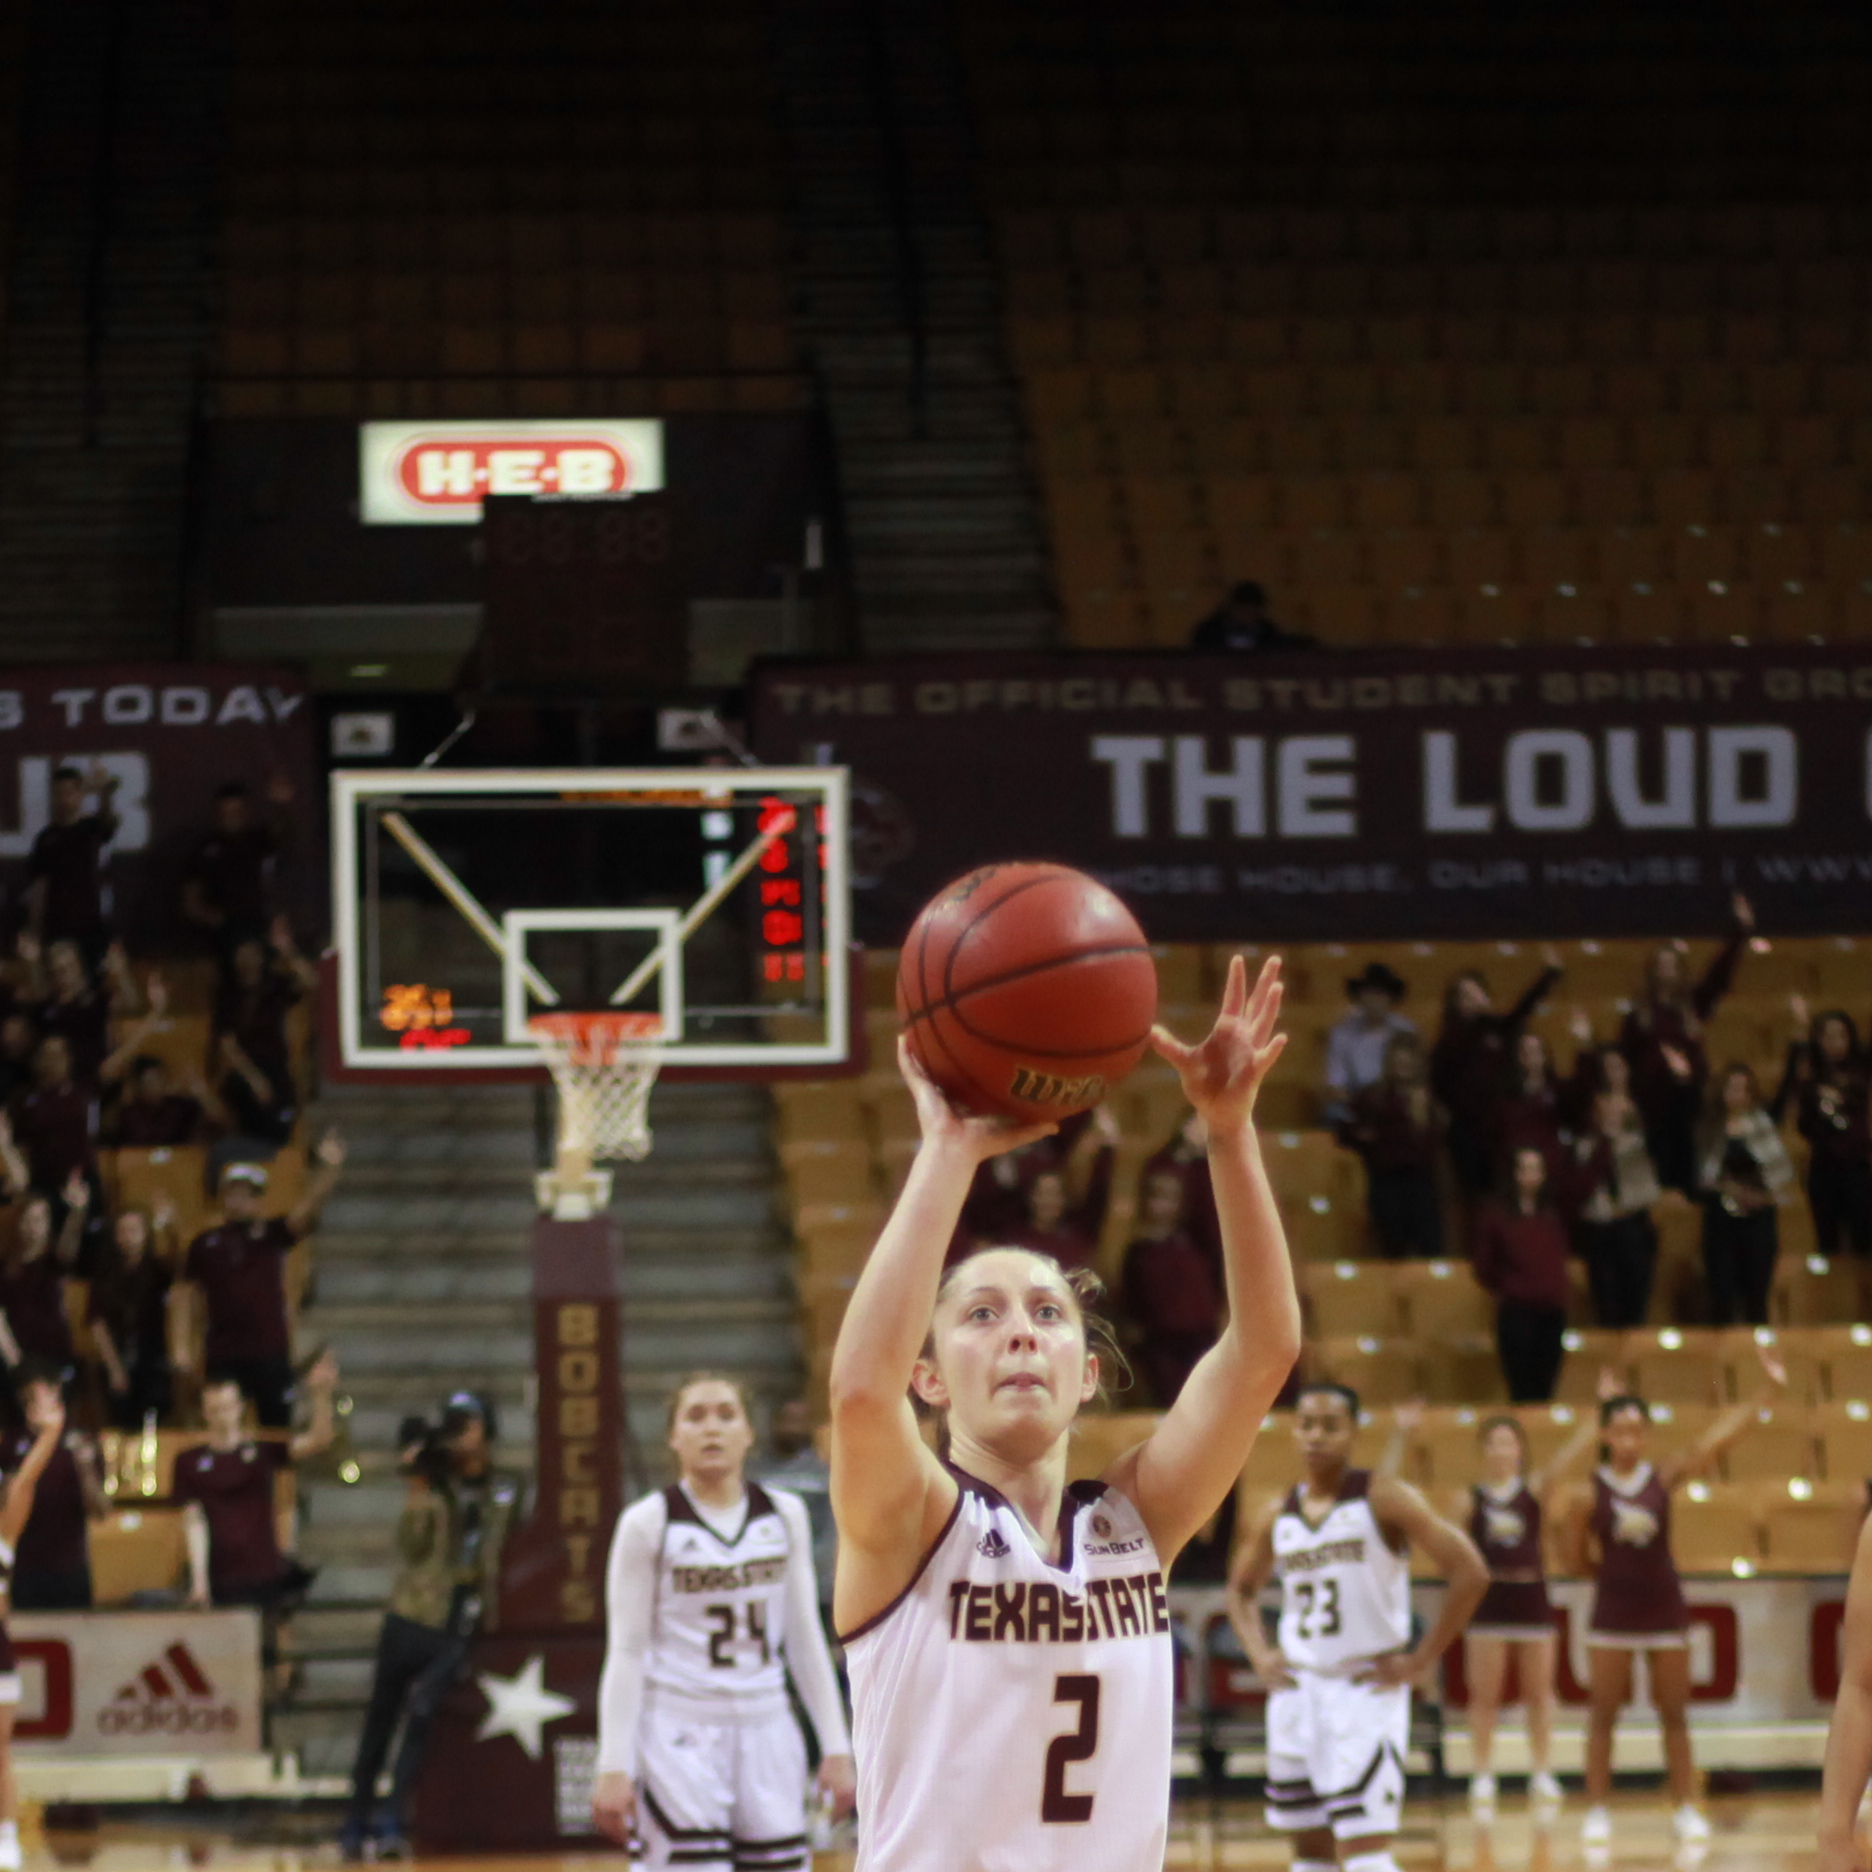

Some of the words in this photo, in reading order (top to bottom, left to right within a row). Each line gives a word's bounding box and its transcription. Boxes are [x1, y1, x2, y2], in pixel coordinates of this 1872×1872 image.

[51, 685, 306, 729] TODAY
[772, 682, 894, 716] THE
[914, 676, 1204, 714] OFFICIAL
[1227, 673, 1520, 711] STUDENT
[1538, 667, 1743, 705] SPIRIT
[1089, 733, 1359, 840] THE
[1421, 722, 1799, 835] LOUD
[1429, 859, 1527, 890] OUR
[1542, 855, 1702, 888] HOUSE
[1295, 1579, 1341, 1638] 23
[97, 1703, 240, 1736] adidas
[1041, 1672, 1100, 1825] 2
